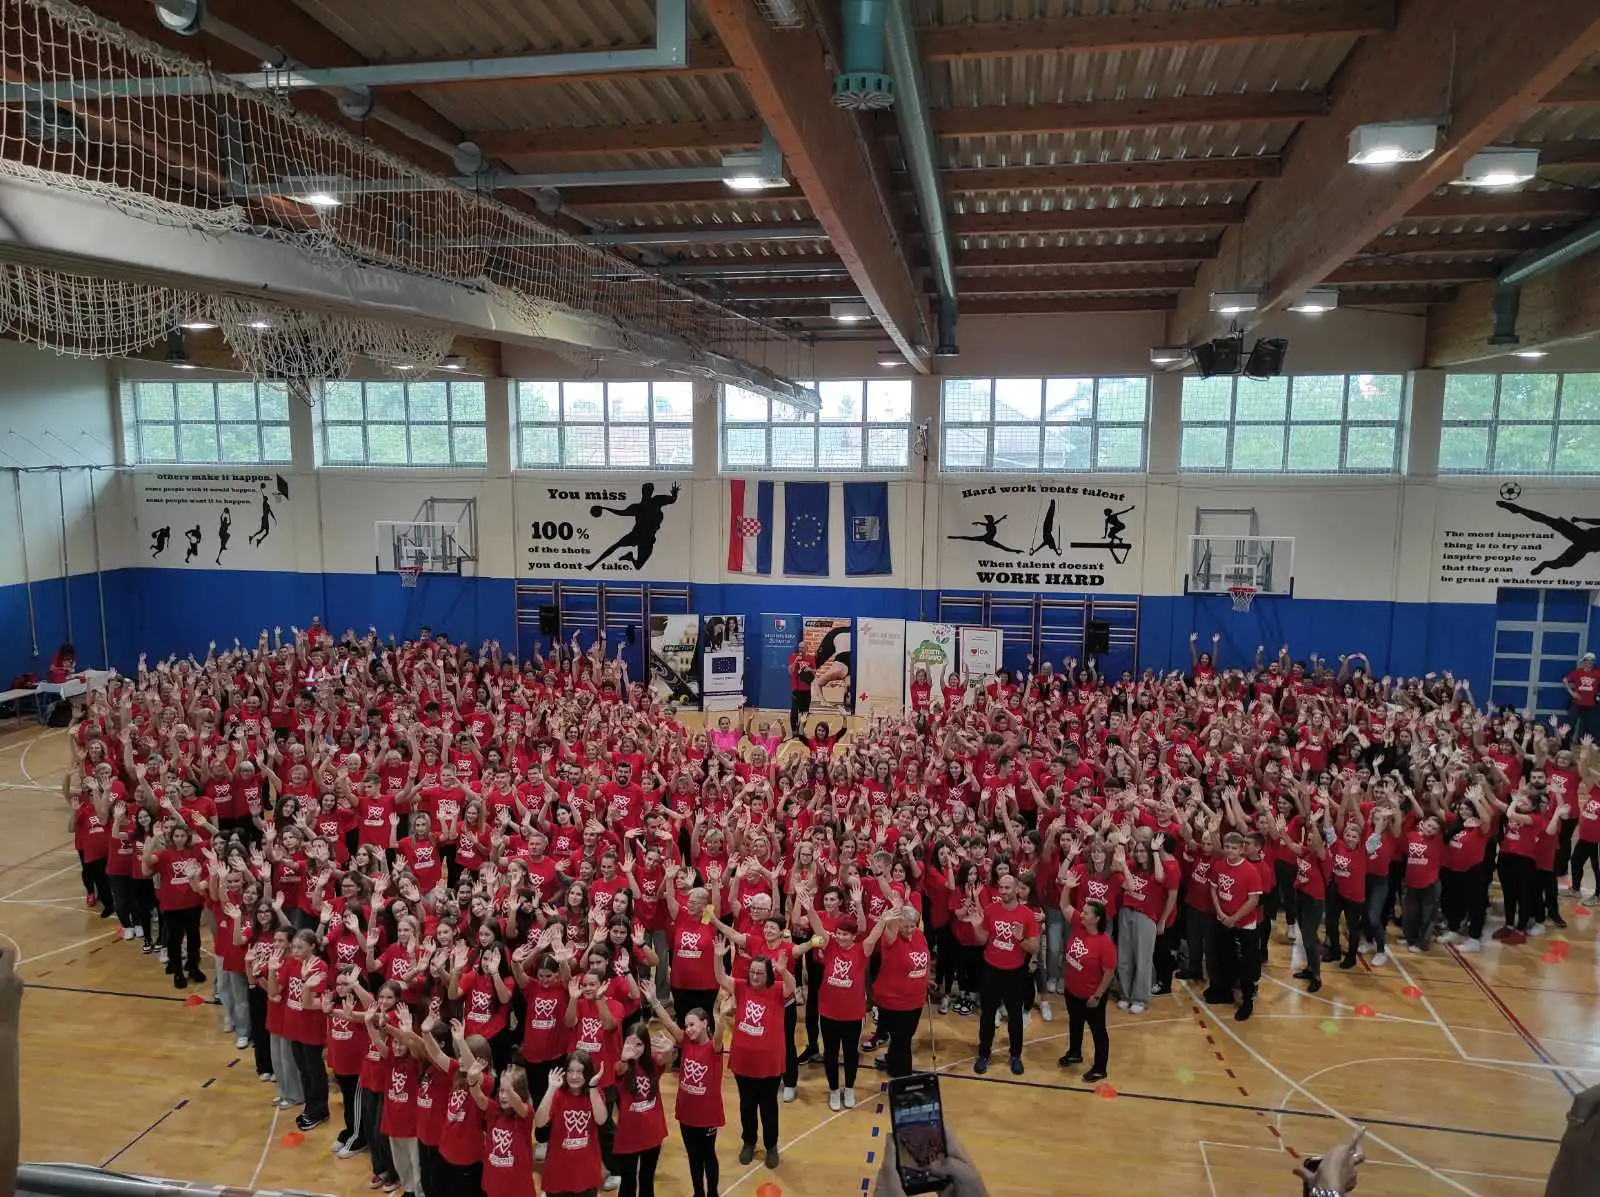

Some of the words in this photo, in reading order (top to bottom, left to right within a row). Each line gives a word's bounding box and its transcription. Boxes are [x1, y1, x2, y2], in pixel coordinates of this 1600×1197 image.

[547, 488, 580, 500] You
[585, 489, 627, 501] miss
[962, 485, 997, 499] Hard
[1000, 484, 1037, 494] work
[1040, 484, 1078, 495] beats
[1082, 487, 1126, 502] talent
[531, 521, 574, 541] 100
[576, 527, 590, 540] %
[1497, 531, 1555, 540] important
[541, 546, 559, 554] the
[561, 546, 591, 555] shots
[1444, 542, 1473, 550] thing
[1502, 543, 1517, 551] try
[1521, 543, 1542, 551] and
[1443, 553, 1482, 562] inspire
[1484, 554, 1521, 563] people
[528, 562, 551, 571] you
[553, 561, 583, 570] dont
[601, 562, 633, 571] take.
[978, 559, 1014, 569] When
[1017, 560, 1055, 569] talent
[1058, 562, 1105, 571] doesn't
[1467, 565, 1491, 574] they
[976, 571, 1040, 585] WORK
[1045, 573, 1105, 586] HARD
[1456, 576, 1485, 584] great
[1557, 579, 1582, 587] they
